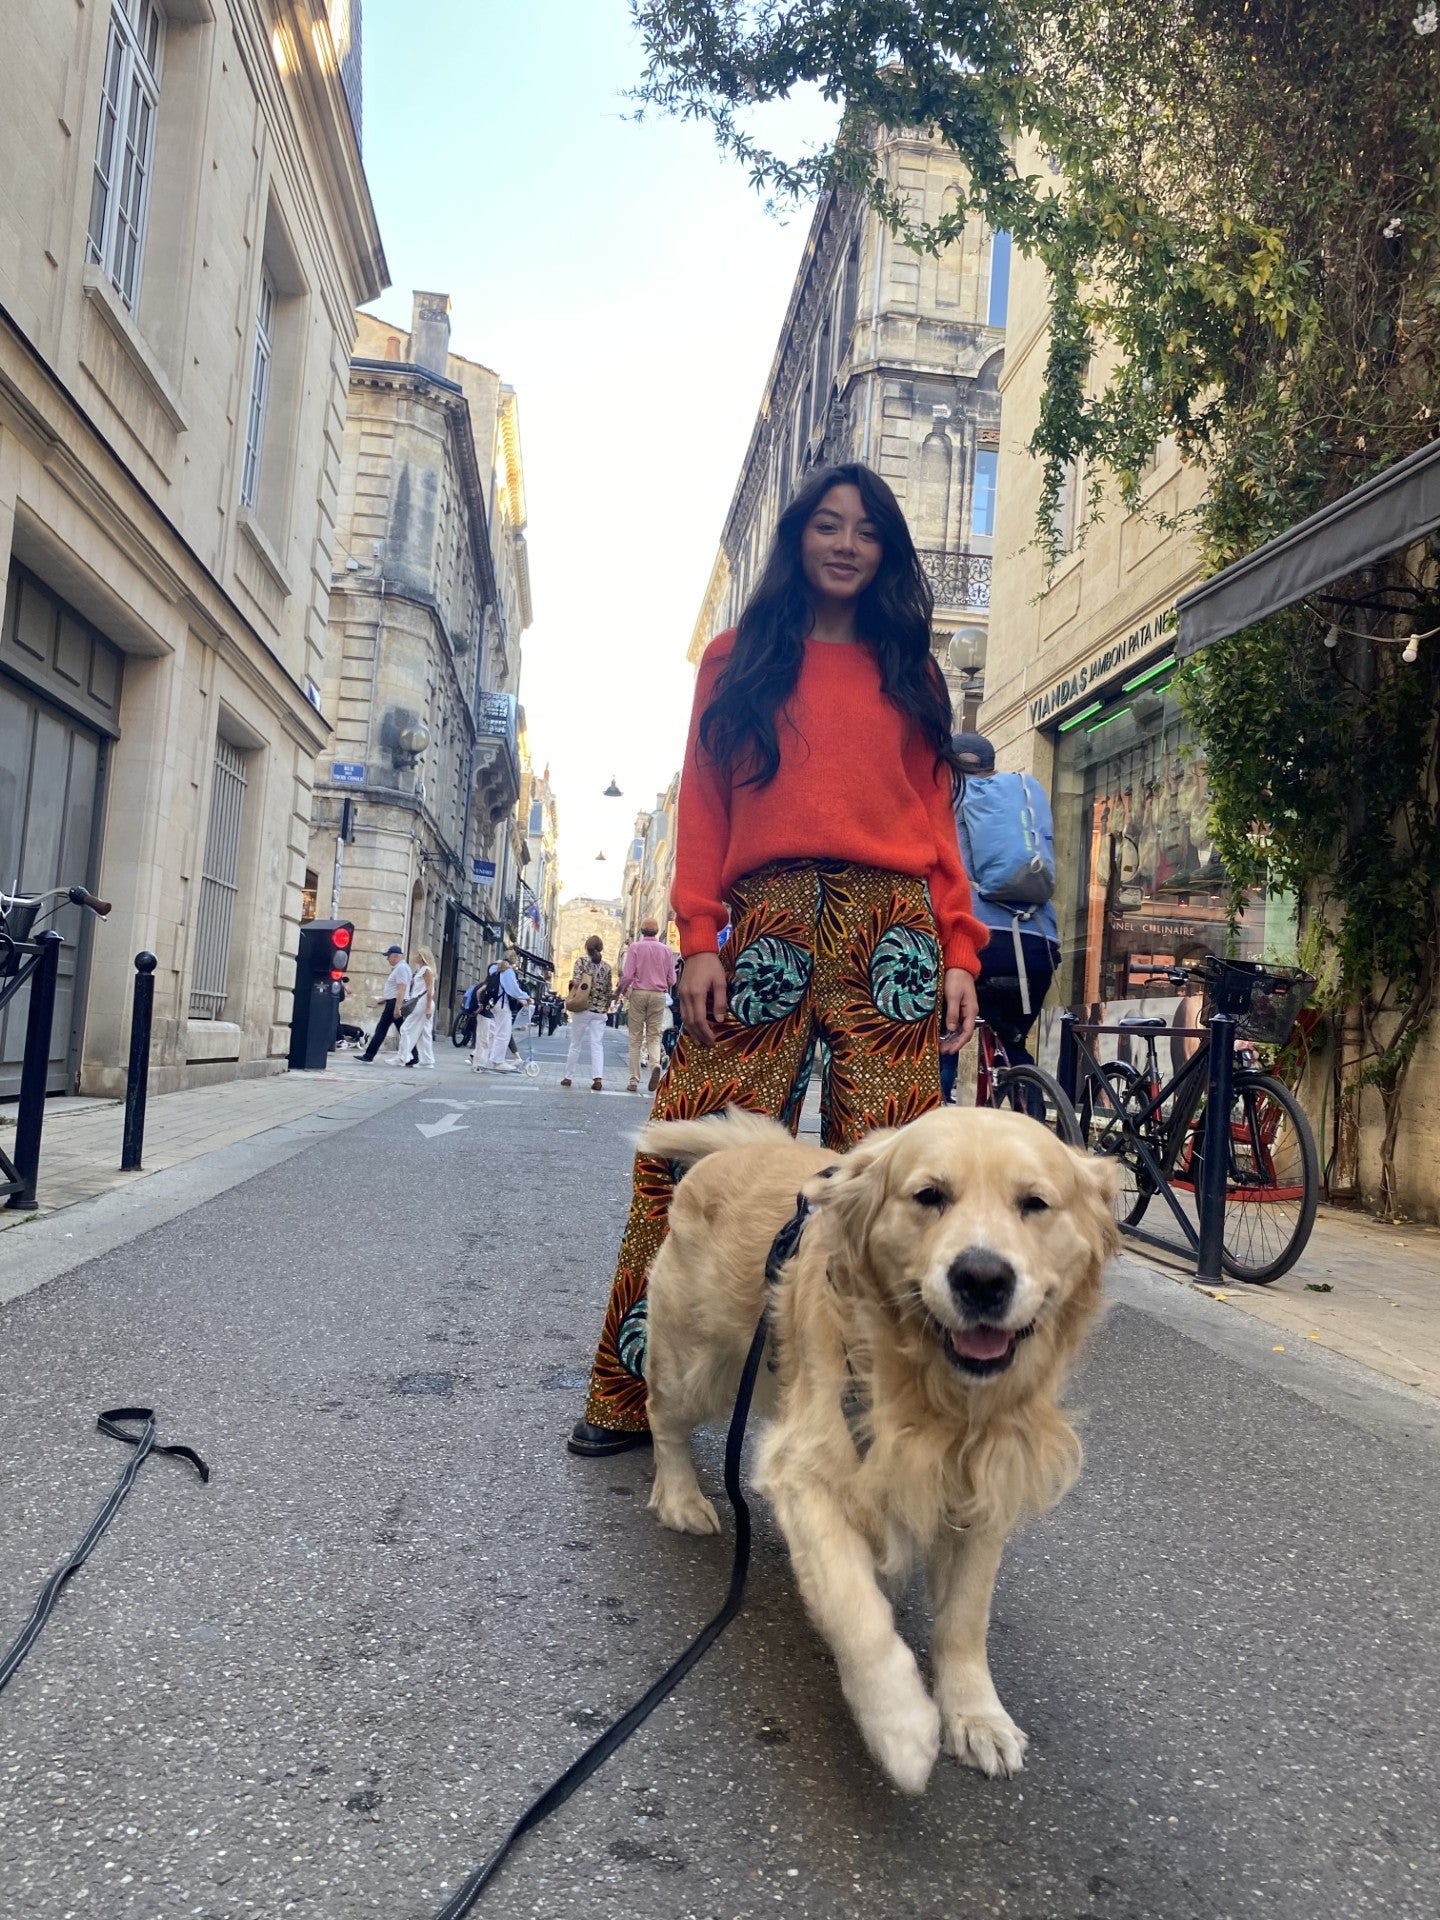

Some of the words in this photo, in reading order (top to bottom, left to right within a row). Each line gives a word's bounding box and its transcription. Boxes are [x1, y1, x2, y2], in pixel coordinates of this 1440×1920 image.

[1029, 667, 1087, 724] VIANDAS
[1088, 640, 1126, 683] JAMBON
[1128, 625, 1152, 655] PATA
[1154, 606, 1175, 637] NE
[474, 867, 493, 876] ENDRE
[1142, 923, 1195, 936] CULINAIRE
